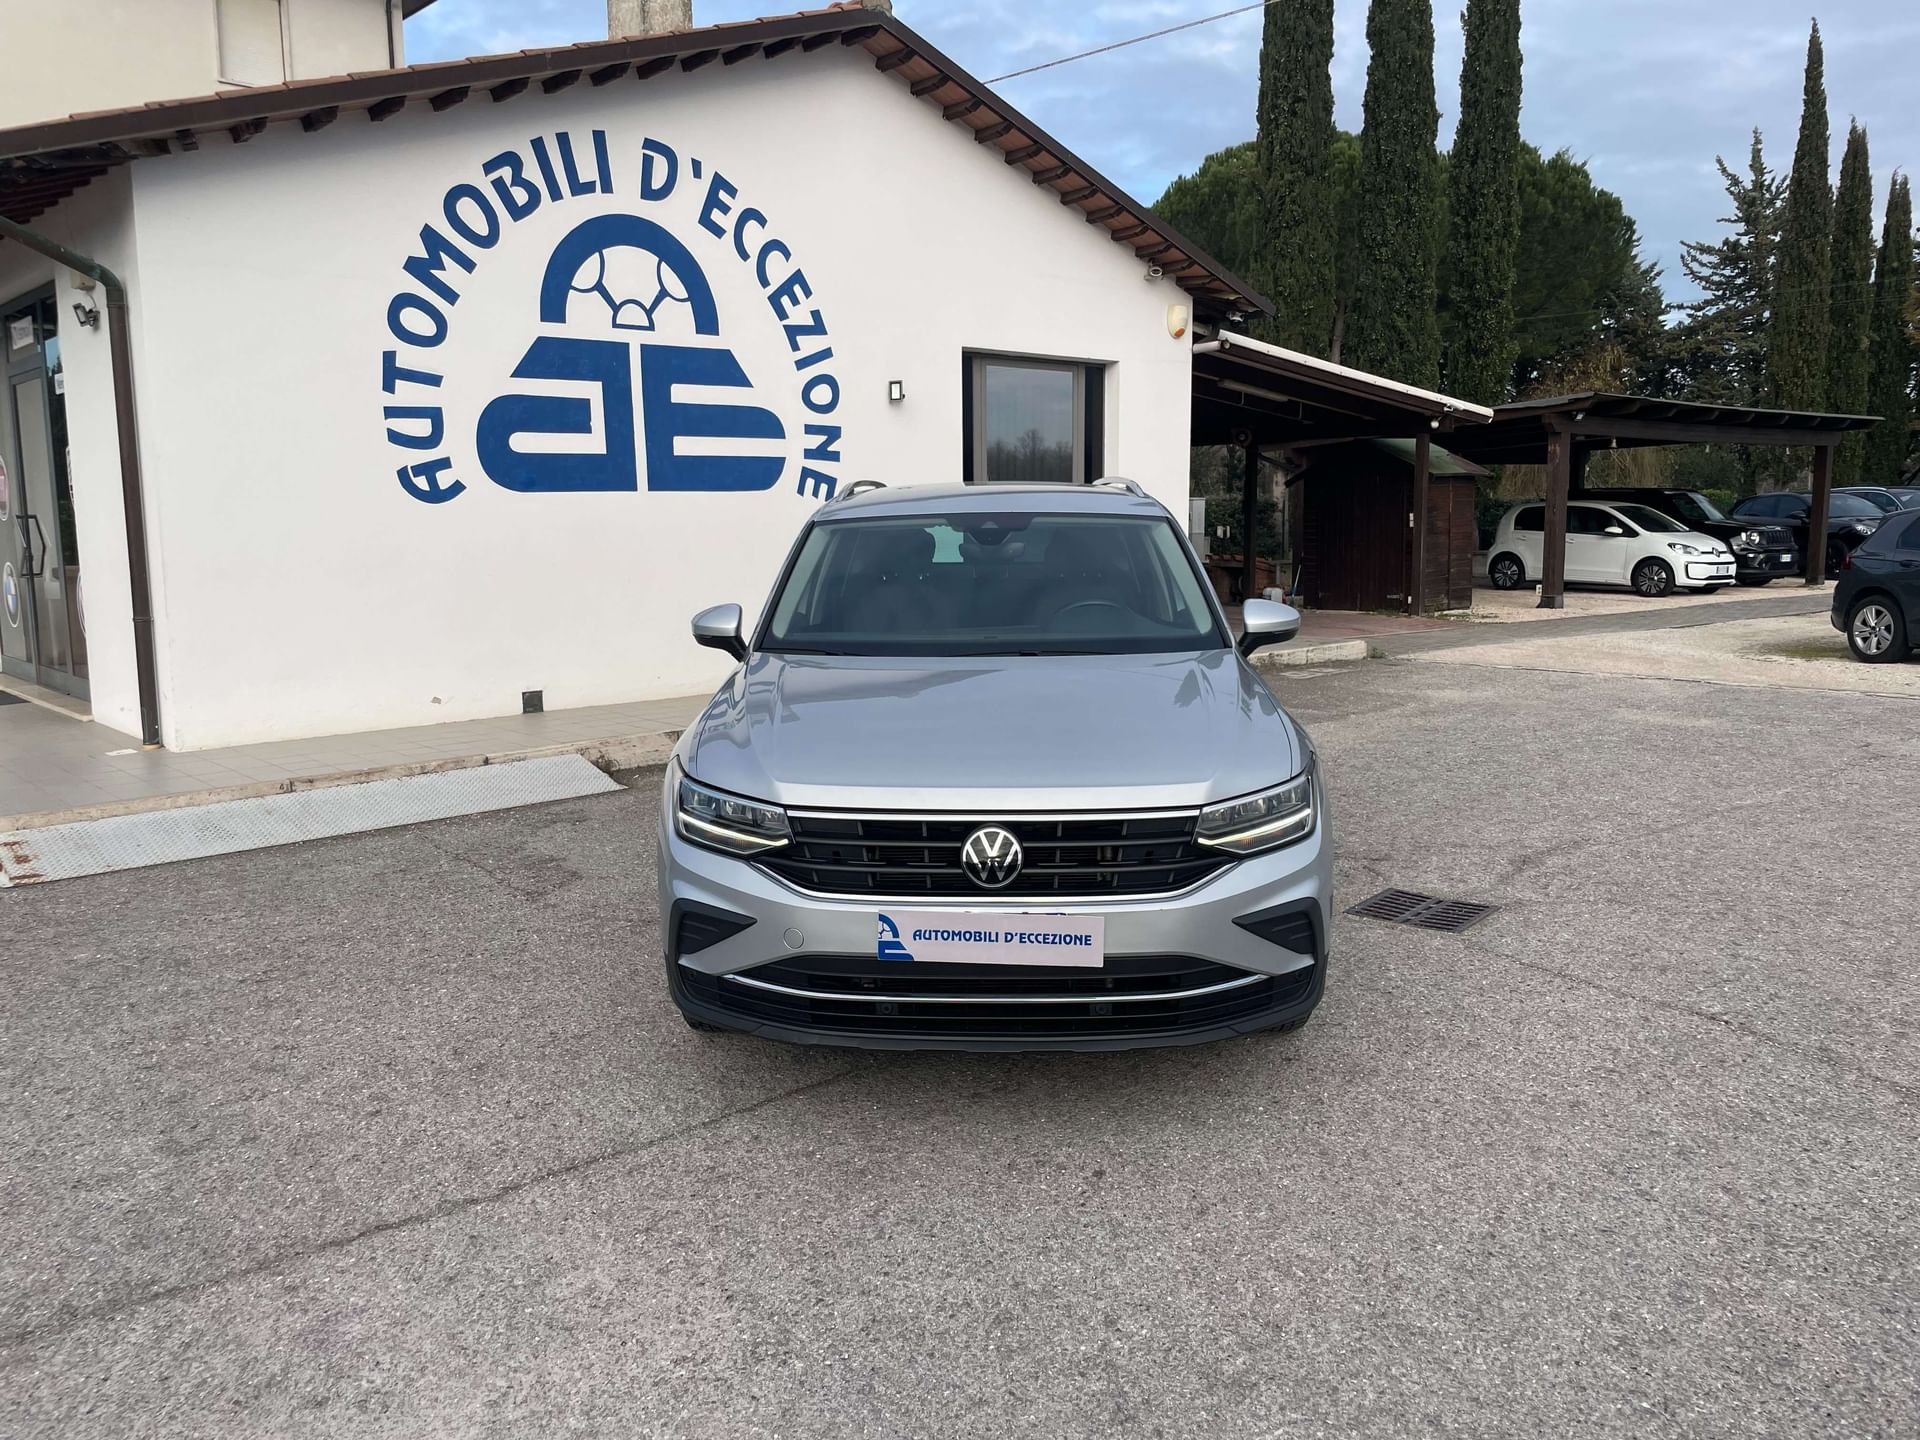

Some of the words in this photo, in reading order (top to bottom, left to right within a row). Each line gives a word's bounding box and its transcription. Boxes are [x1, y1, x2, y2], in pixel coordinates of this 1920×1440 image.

[382, 129, 613, 504] AUTOMOBILI
[640, 137, 842, 502] D'ECCEZIONE
[912, 929, 1000, 943] AUTOMOBILI
[1004, 931, 1093, 946] D'ECCEZIONE
